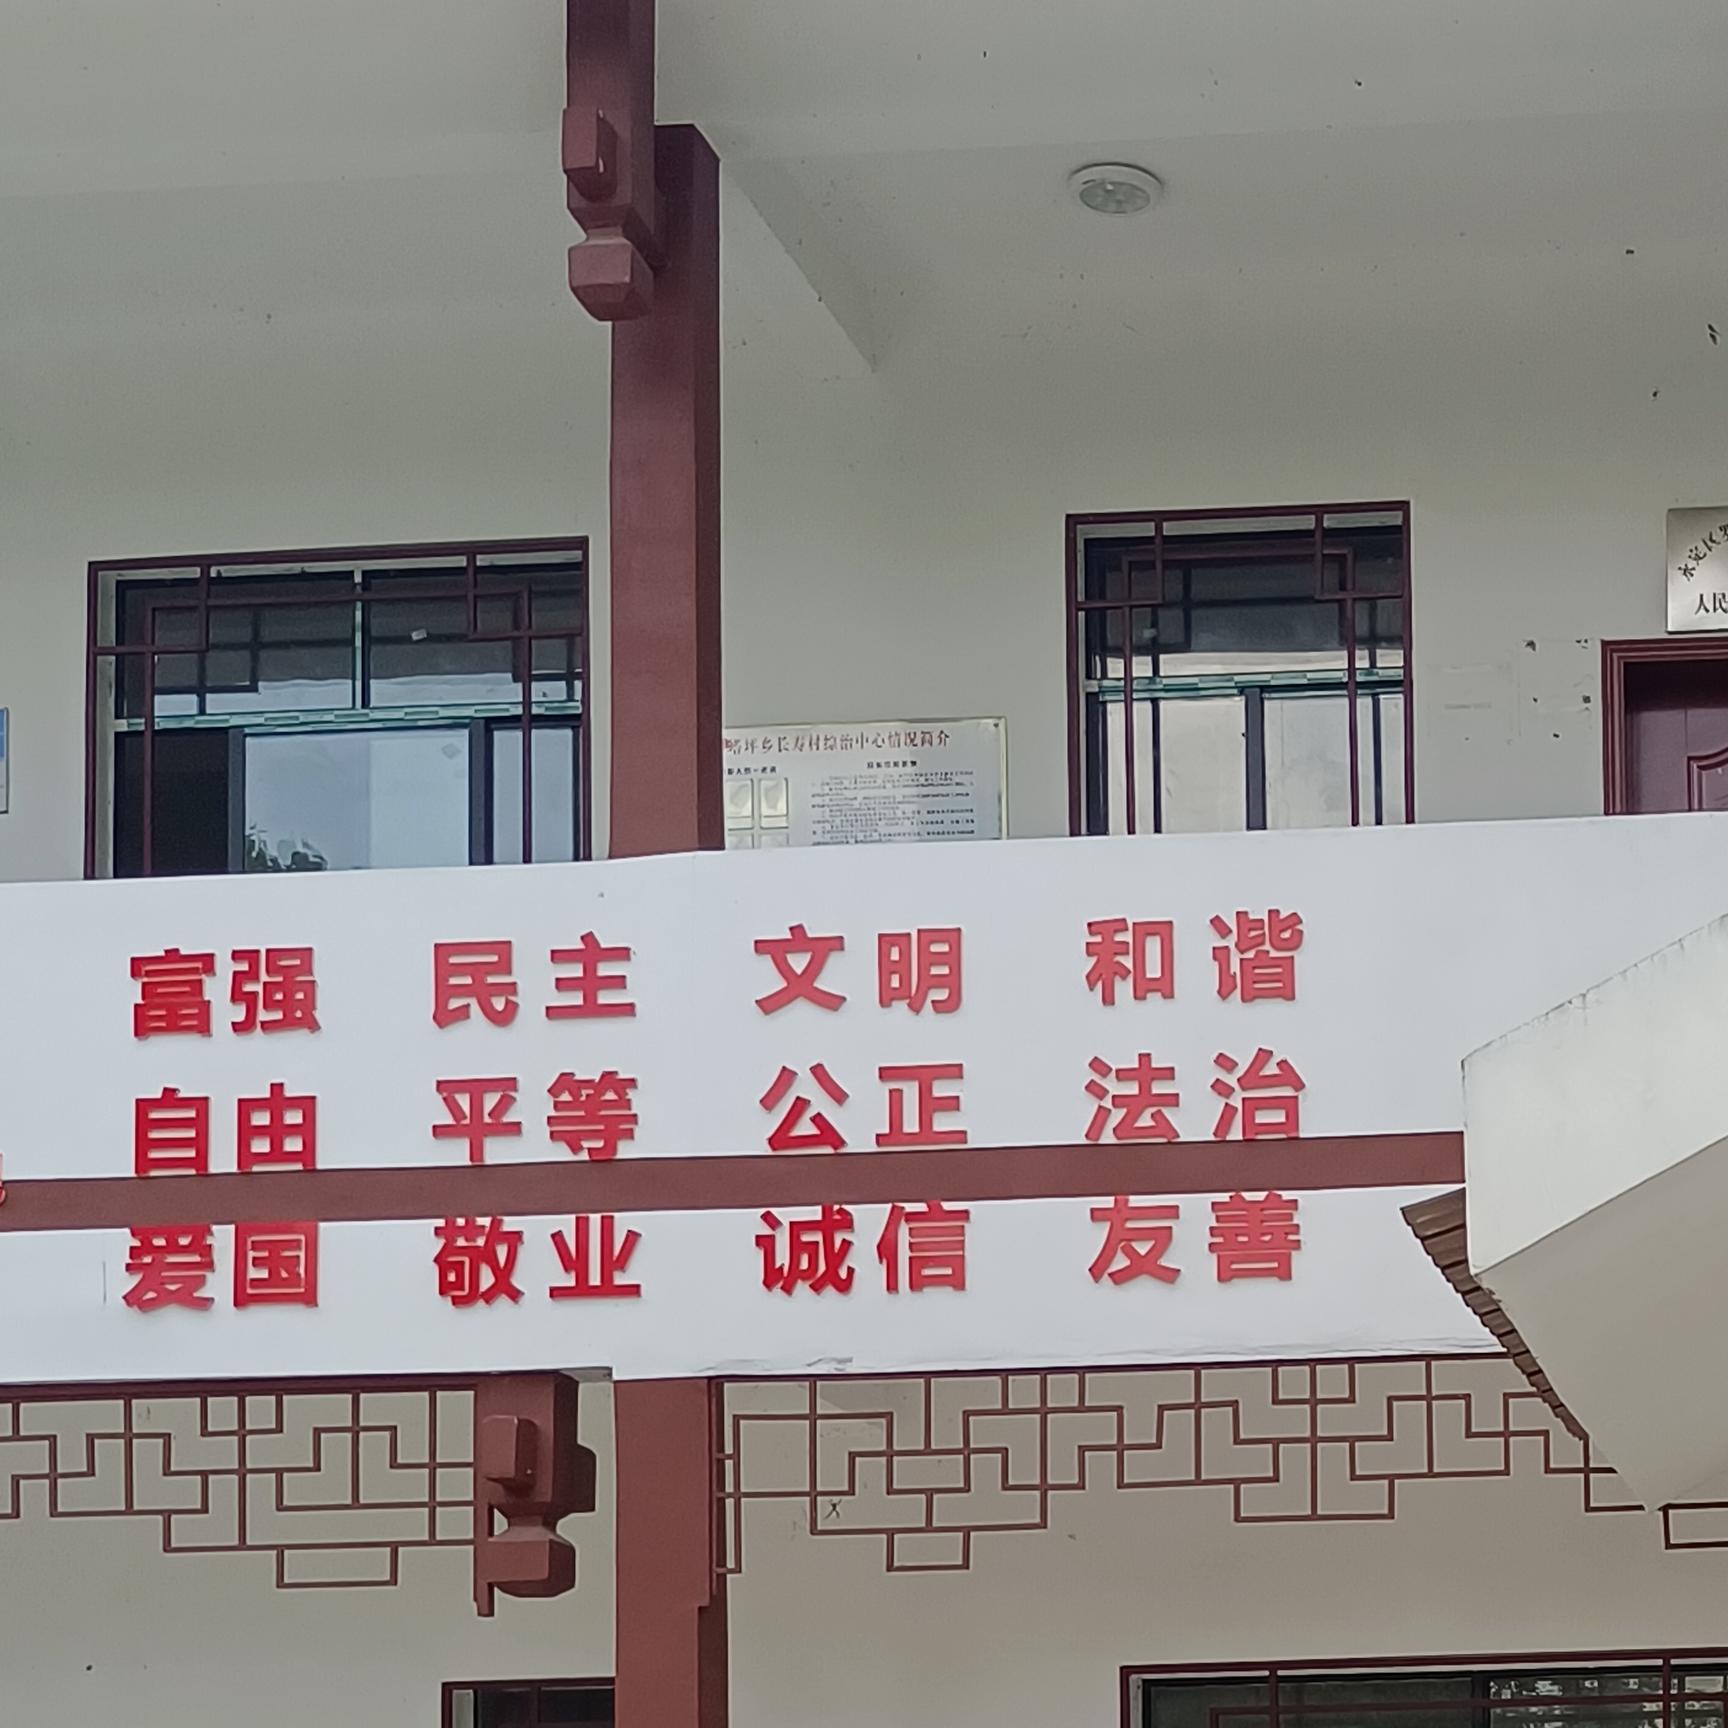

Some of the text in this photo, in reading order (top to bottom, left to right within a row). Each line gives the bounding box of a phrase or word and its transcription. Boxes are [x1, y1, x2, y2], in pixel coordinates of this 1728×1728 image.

[130, 908, 1304, 1041] 富强 民主 文明 和谐
[135, 1047, 1306, 1177] 自由 平等 公正 法治
[122, 1190, 1302, 1312] 爱国 敬业 诚信 友善
